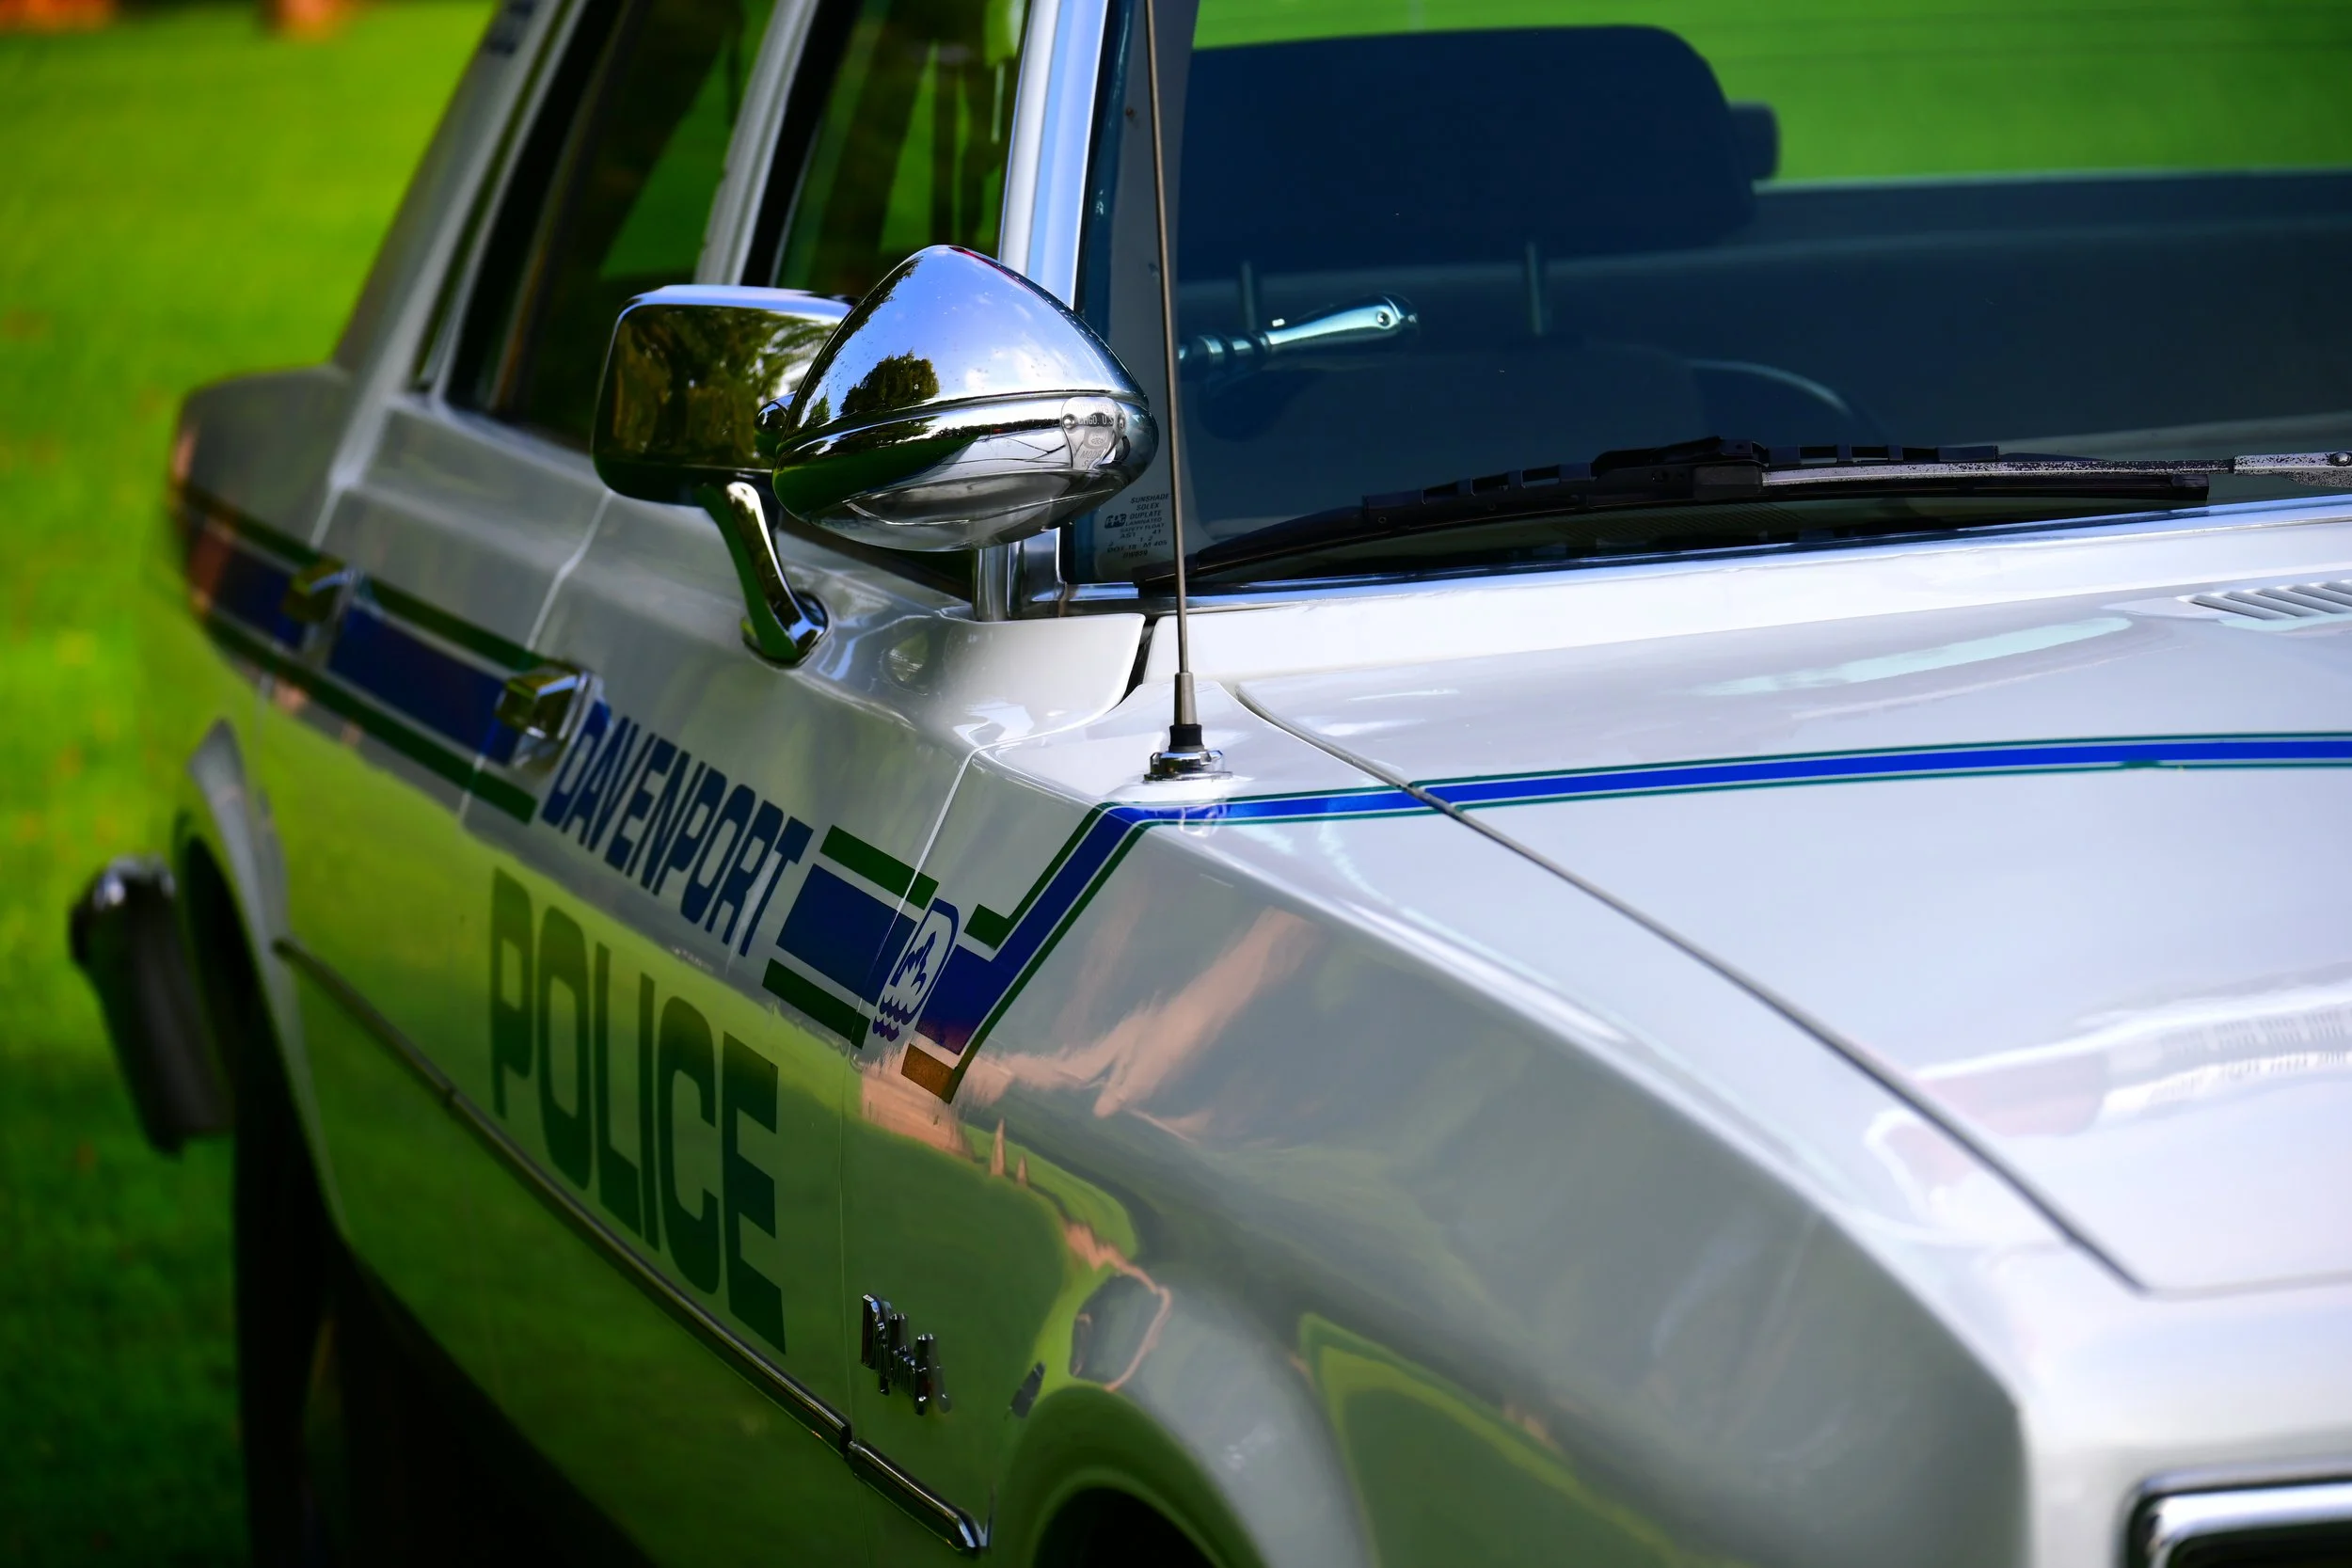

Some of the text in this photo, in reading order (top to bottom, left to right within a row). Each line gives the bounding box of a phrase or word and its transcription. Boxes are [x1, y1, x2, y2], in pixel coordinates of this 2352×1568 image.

[1130, 493, 1169, 503] SUNSHADE
[1136, 502, 1160, 511] SOLEX
[1129, 510, 1162, 519] DUPLATE
[1125, 517, 1163, 527] LAMINATED
[1144, 523, 1165, 531] FLOAT
[541, 701, 814, 958] DAVENPORT
[491, 866, 787, 1355] POLICE
